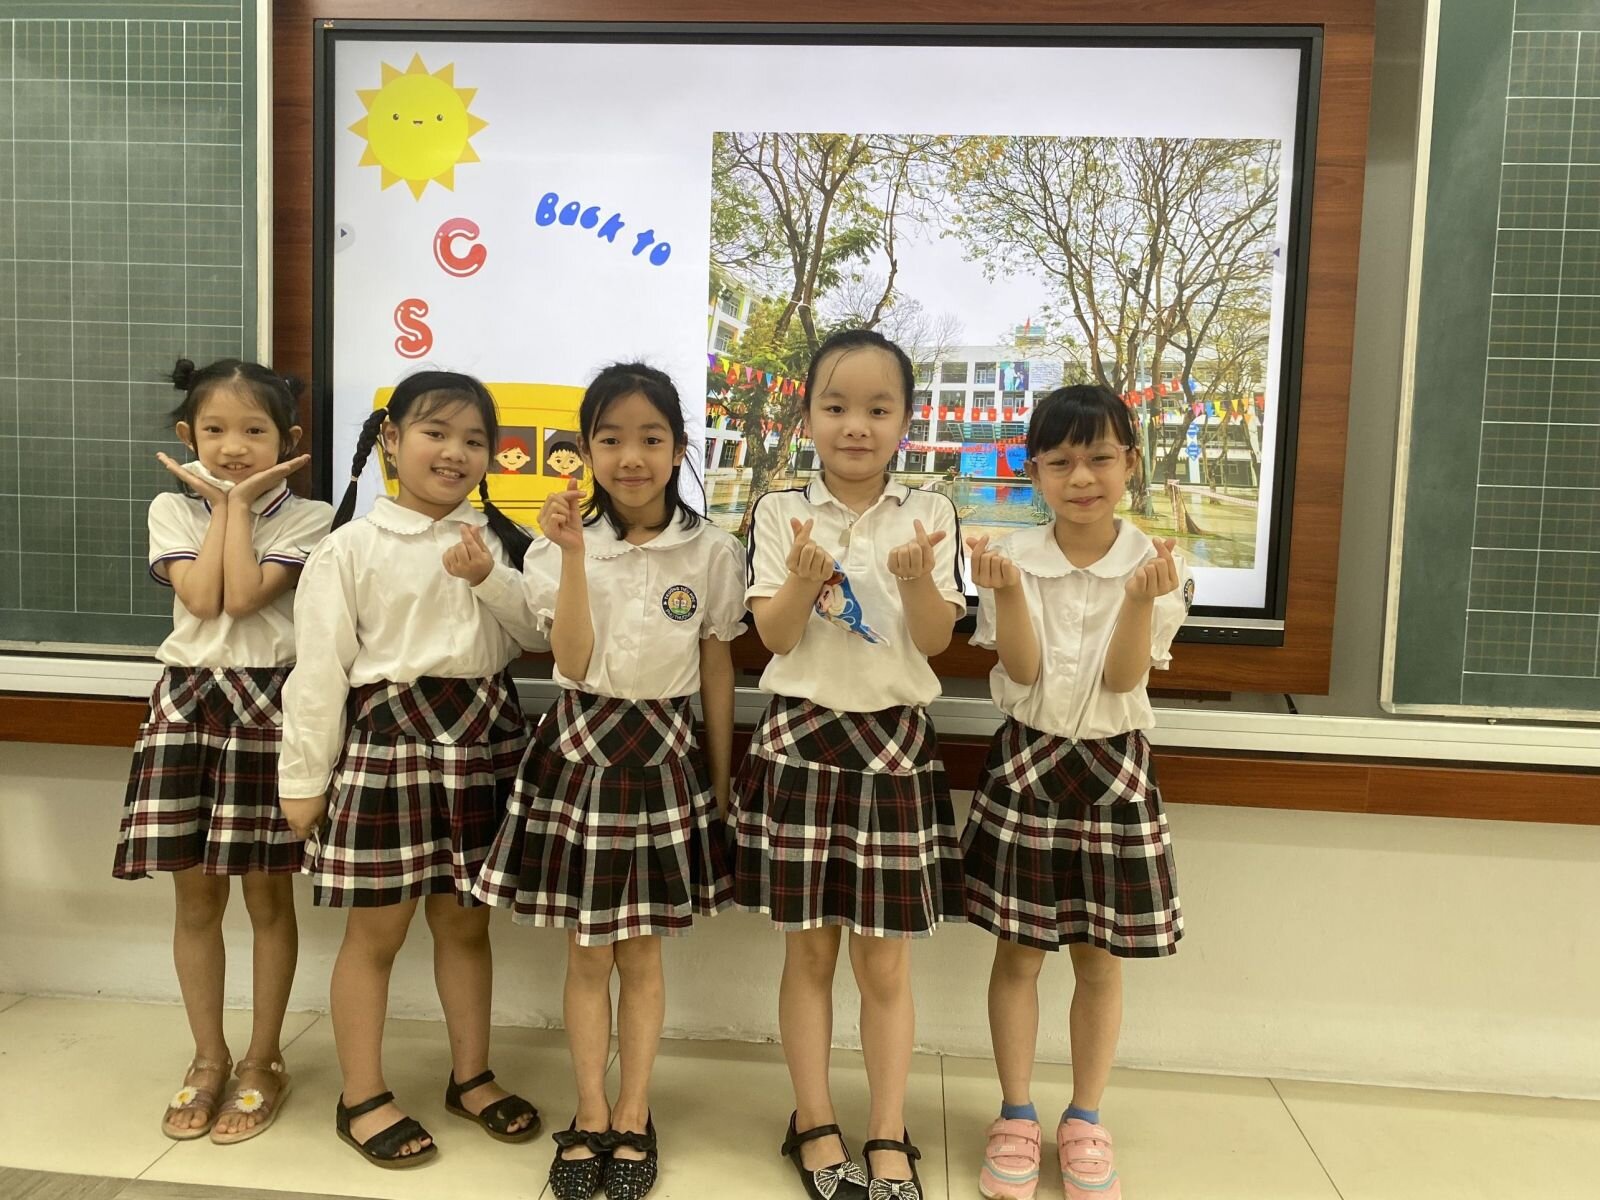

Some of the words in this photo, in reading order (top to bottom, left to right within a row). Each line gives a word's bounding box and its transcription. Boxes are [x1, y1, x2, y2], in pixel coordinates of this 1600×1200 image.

[432, 217, 488, 278] C
[535, 192, 625, 243] Back
[632, 229, 672, 266] to
[393, 297, 434, 360] S
